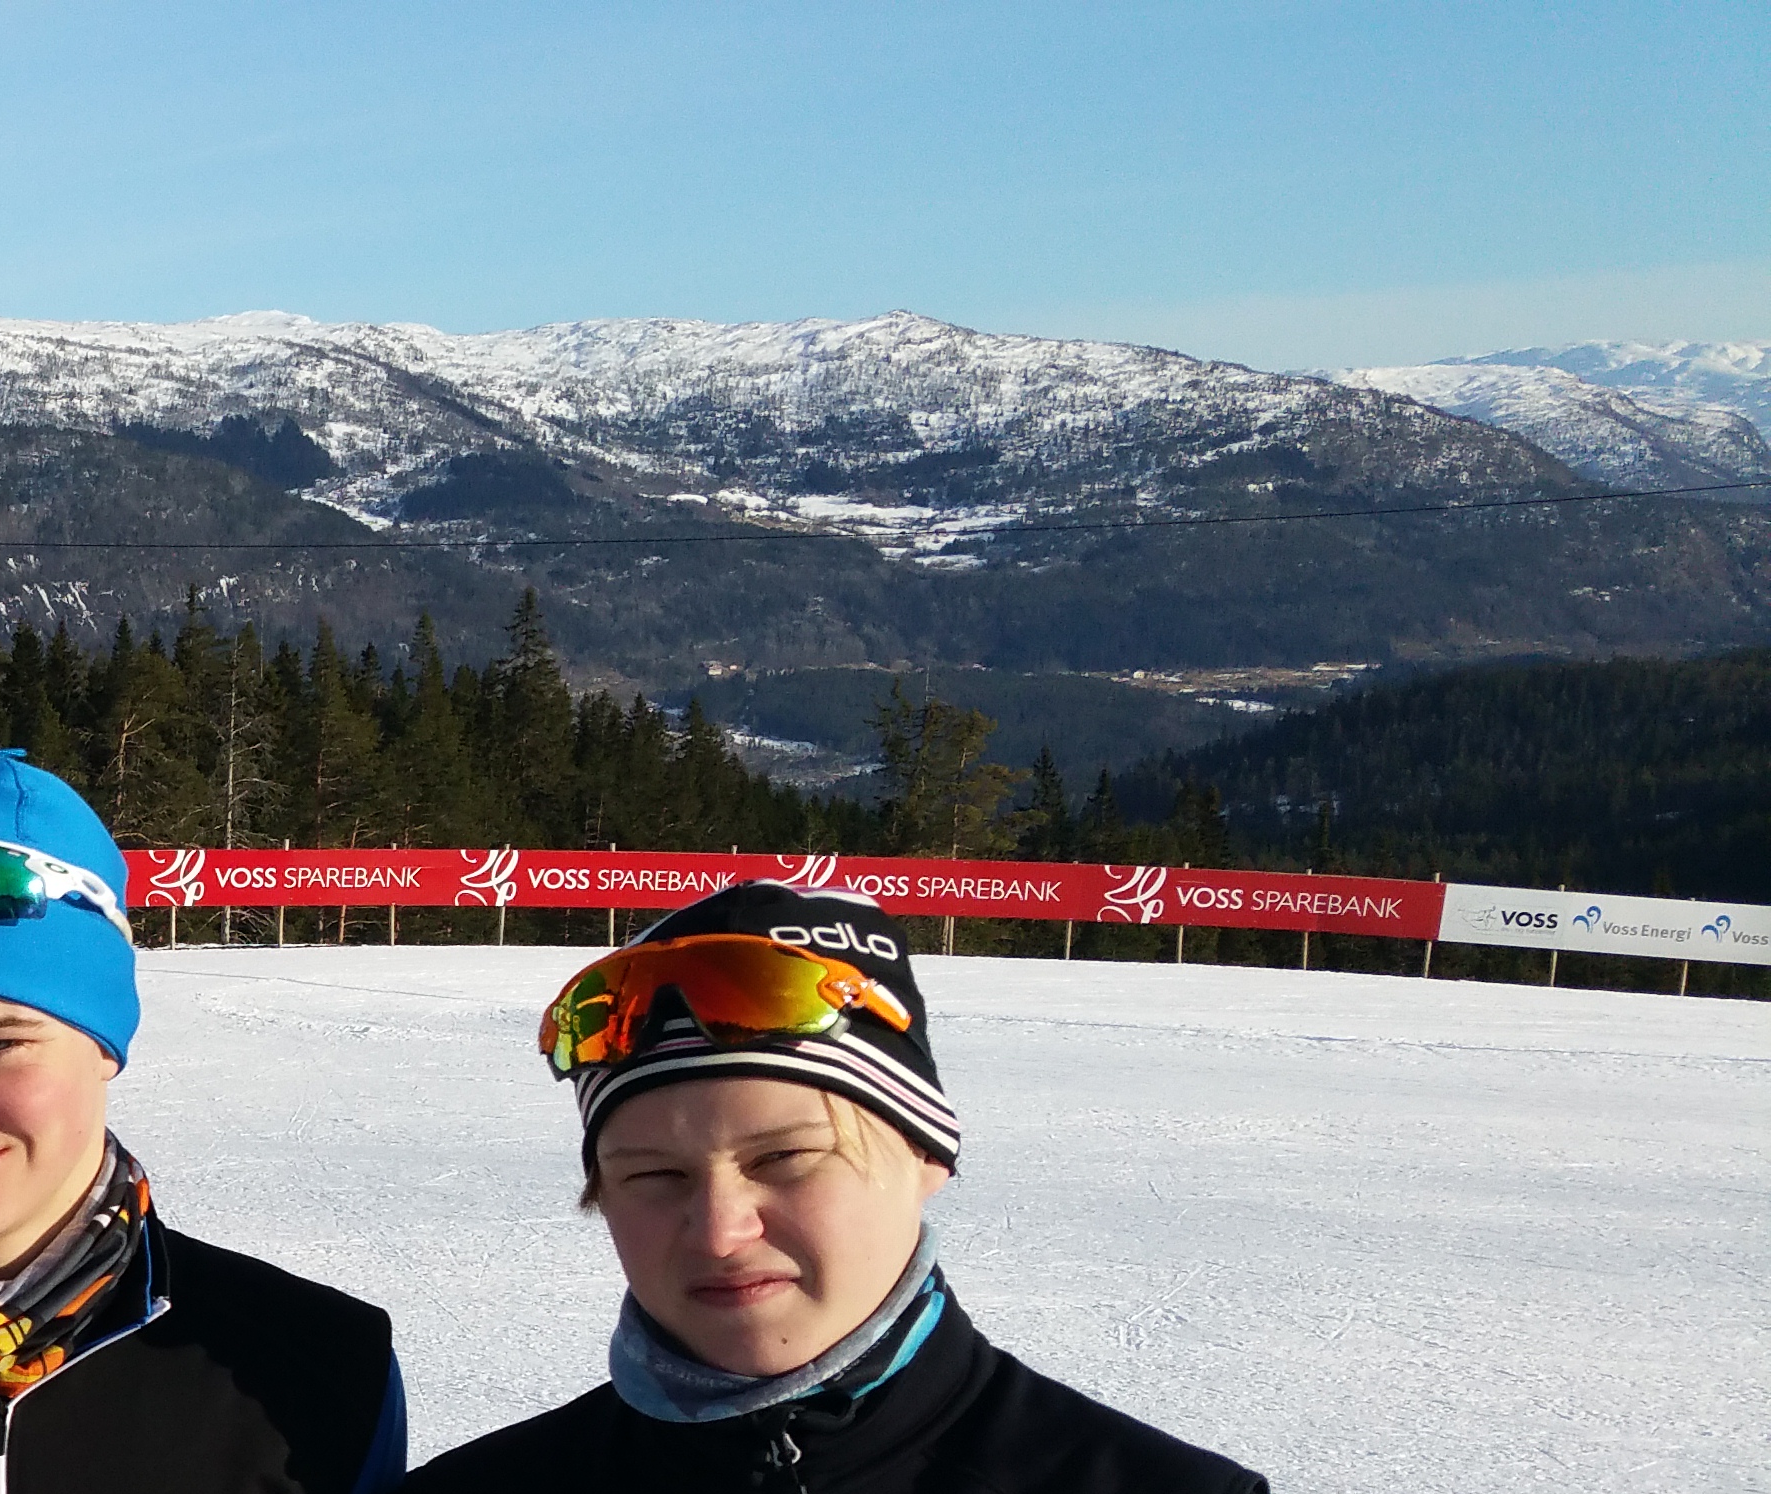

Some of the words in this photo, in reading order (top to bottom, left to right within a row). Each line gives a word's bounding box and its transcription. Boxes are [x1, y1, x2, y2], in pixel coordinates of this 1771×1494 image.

[215, 867, 277, 888] VOSS
[284, 867, 421, 888] SPAREBANK
[528, 868, 590, 889] VOSS
[597, 869, 736, 892] SPAREBANK
[845, 875, 909, 897] VOSS
[917, 877, 1062, 902] SPAREBANK
[1176, 886, 1244, 910] VOSS
[1251, 890, 1402, 919] SPAREBANK
[1501, 910, 1558, 929] VOSS
[769, 922, 899, 961] odlo
[1602, 921, 1639, 936] Voss
[1641, 924, 1692, 942] Energi
[1732, 931, 1769, 946] Voss
